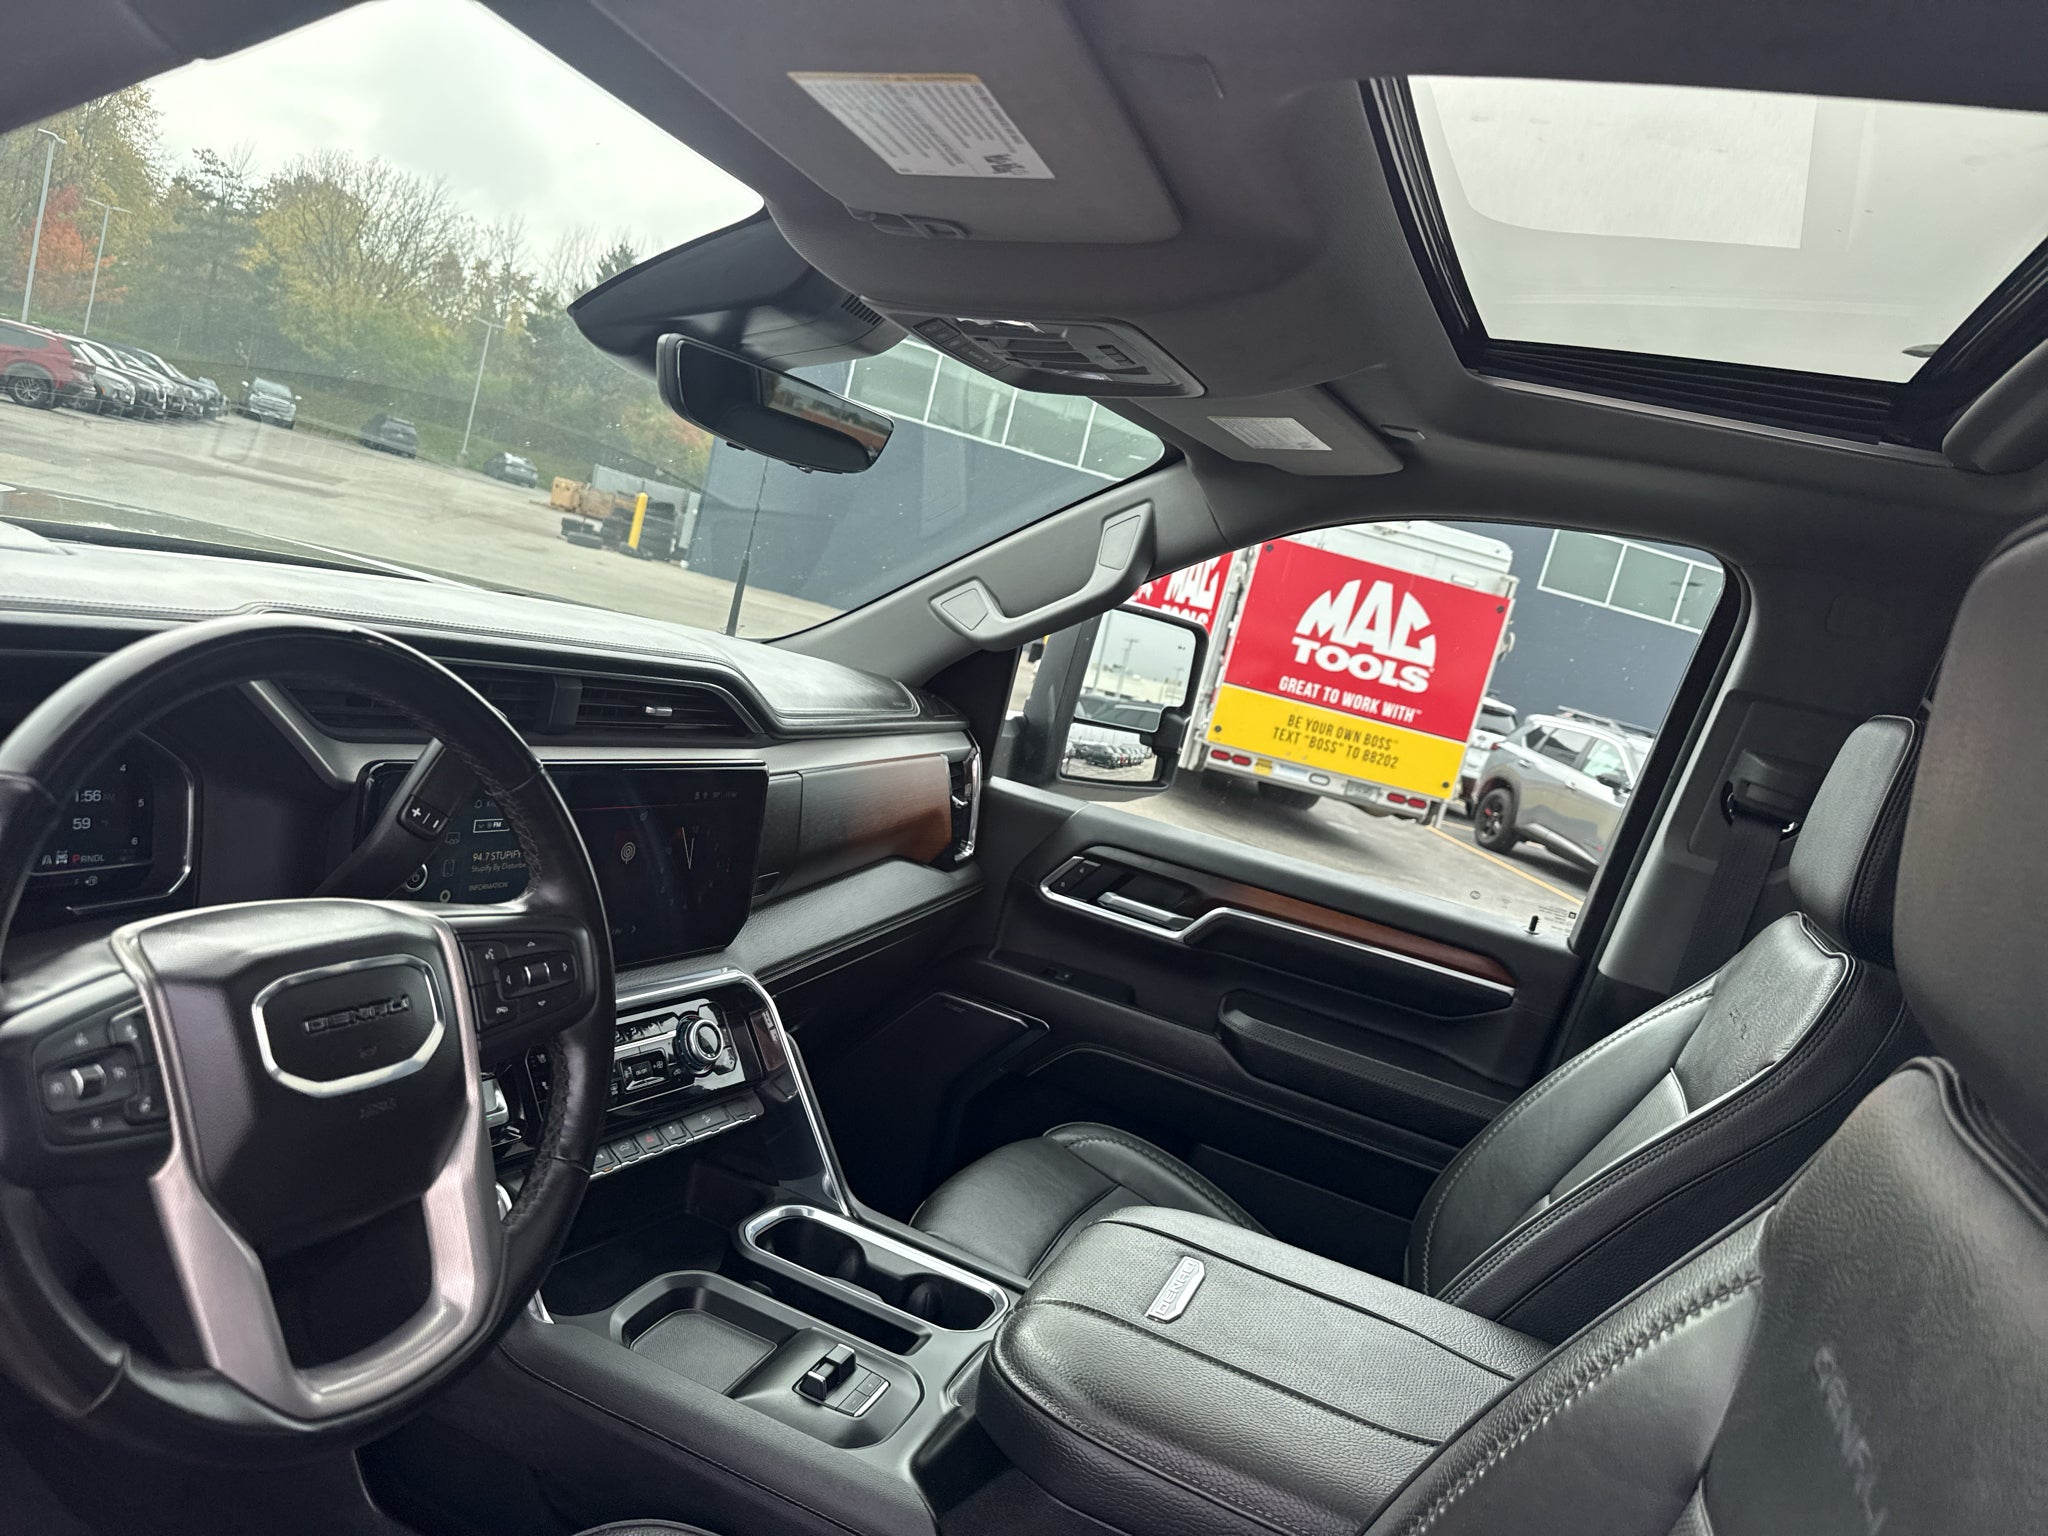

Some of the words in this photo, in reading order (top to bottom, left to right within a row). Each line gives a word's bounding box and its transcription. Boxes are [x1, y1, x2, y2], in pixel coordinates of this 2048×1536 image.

[1160, 604, 1210, 625] OLS
[1295, 579, 1436, 668] MAC
[1291, 636, 1430, 693] TOOLS
[1279, 675, 1322, 700] GREAT
[1323, 685, 1340, 704] TO
[1341, 691, 1380, 714] WORK
[1287, 714, 1303, 729] BE
[1305, 717, 1334, 737] YOUR
[1336, 726, 1361, 744] OWN
[1272, 727, 1301, 745] TEXT
[1346, 745, 1361, 761] TO
[1362, 749, 1399, 769] 88202
[119, 763, 127, 772] 4
[138, 798, 145, 808] 5
[72, 817, 91, 830] 59
[130, 836, 138, 845] 6
